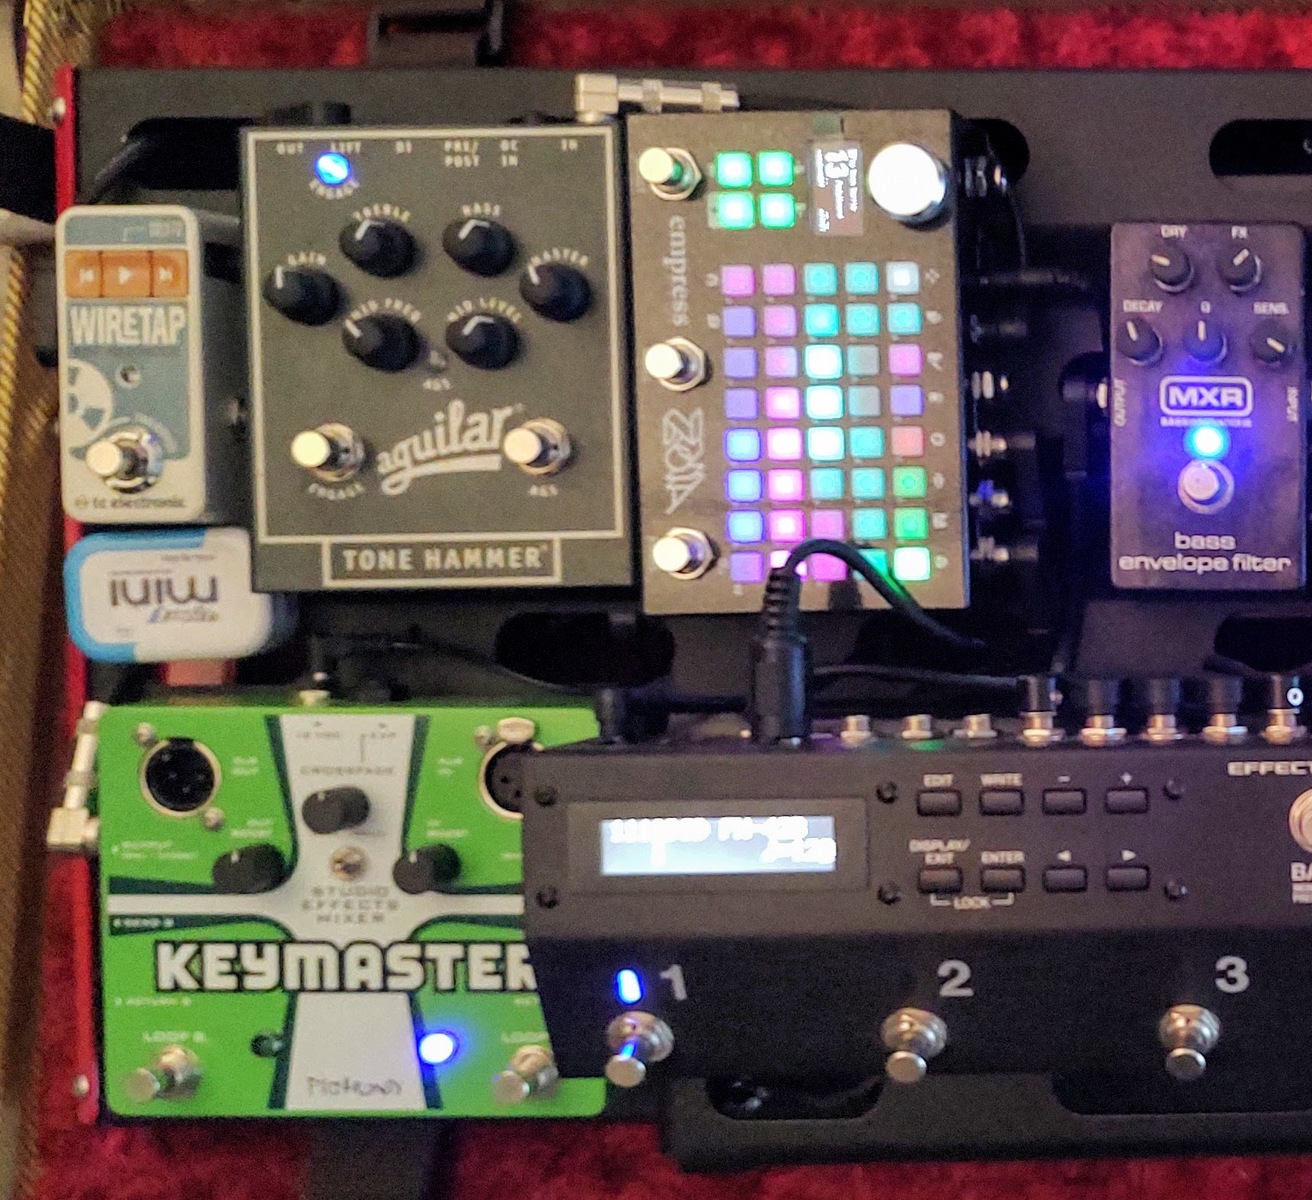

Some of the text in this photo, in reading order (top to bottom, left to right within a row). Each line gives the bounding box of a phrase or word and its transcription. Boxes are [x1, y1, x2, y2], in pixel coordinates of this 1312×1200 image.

[69, 306, 187, 347] WIRETAP
[1168, 385, 1244, 407] MXR
[377, 399, 515, 496] aguilar
[1174, 531, 1236, 550] bass
[343, 545, 542, 572] TONE HAMMER
[1118, 553, 1292, 575] envelope filter
[923, 773, 954, 787] EDIT
[980, 773, 1023, 787] WRITE
[909, 839, 971, 852] DISPLAY/
[925, 852, 954, 865] EXIT
[980, 851, 1025, 865] ENTER
[953, 896, 991, 909] LOCK
[661, 964, 688, 1000] 1
[937, 959, 974, 997] 2
[1215, 956, 1250, 993] 3
